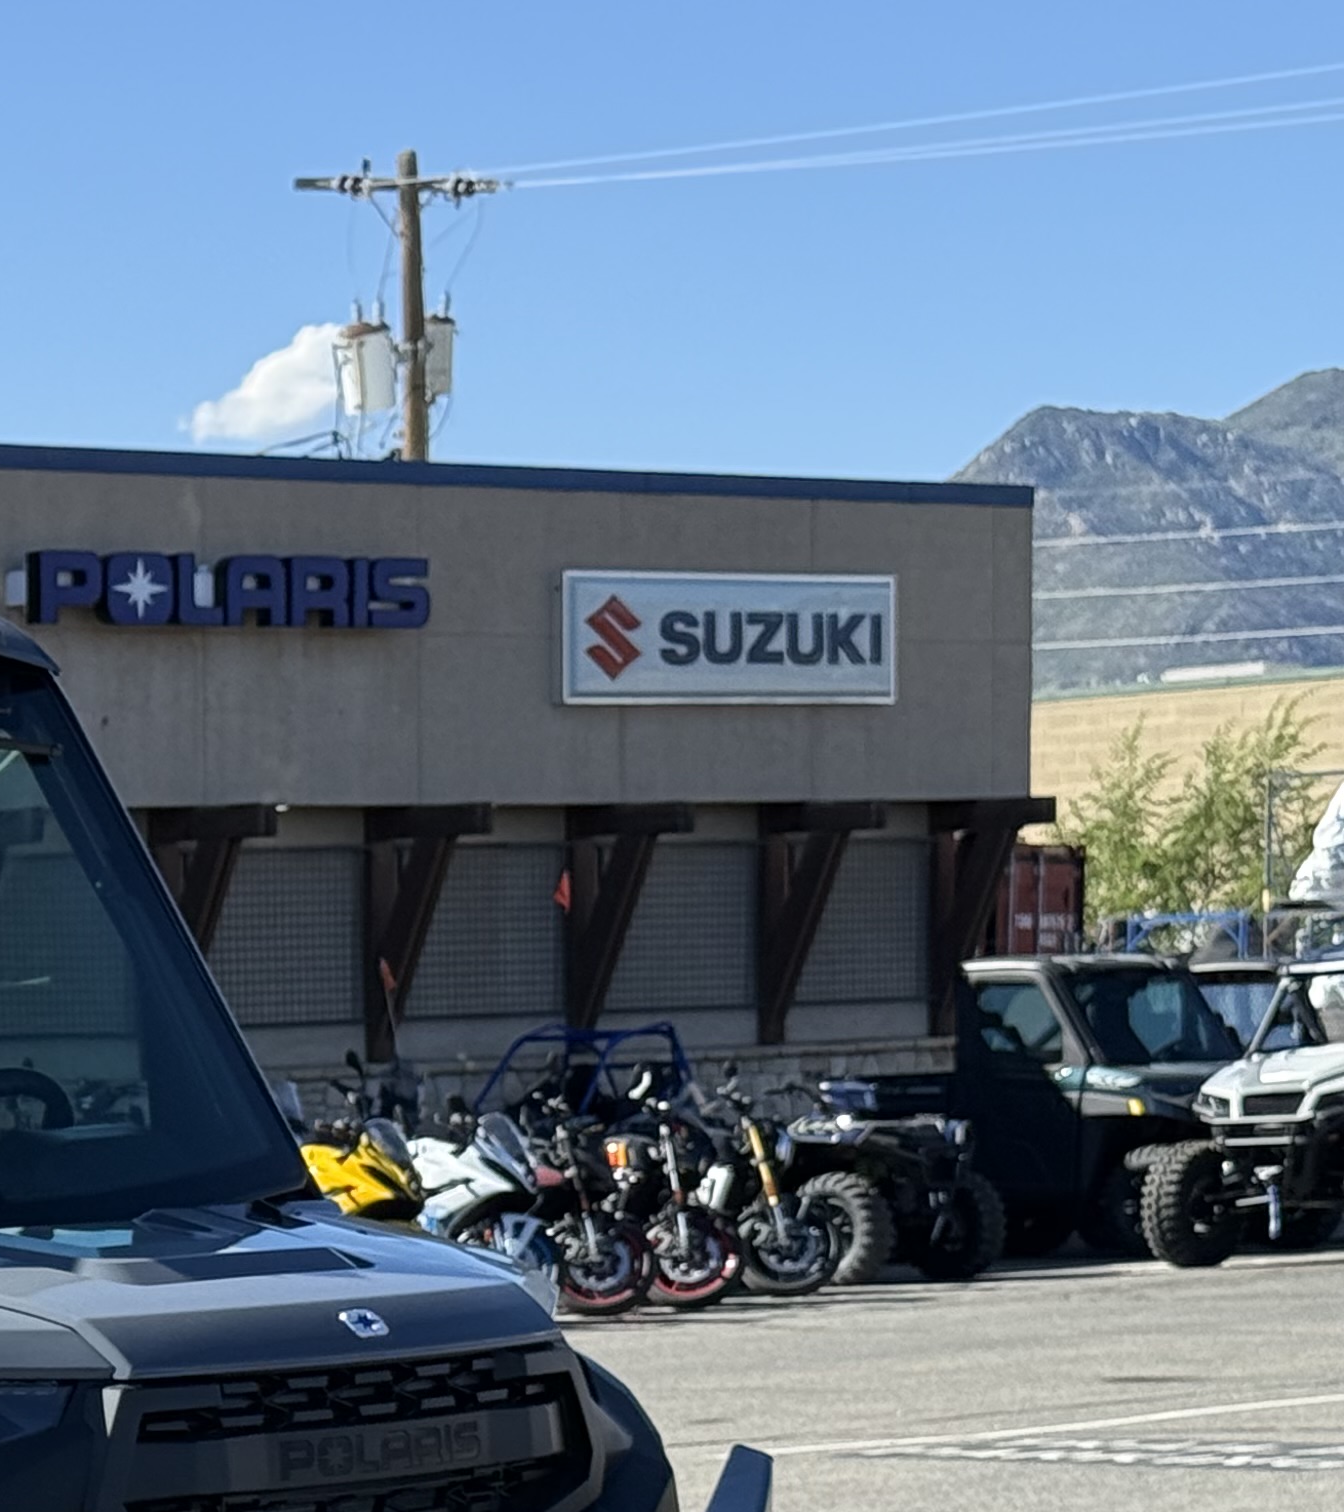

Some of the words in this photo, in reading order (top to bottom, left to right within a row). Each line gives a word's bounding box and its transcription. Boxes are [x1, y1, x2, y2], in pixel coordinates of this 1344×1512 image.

[26, 549, 431, 629] POLARIS
[659, 610, 883, 667] SUZUKI
[279, 1420, 482, 1482] POLARIS
